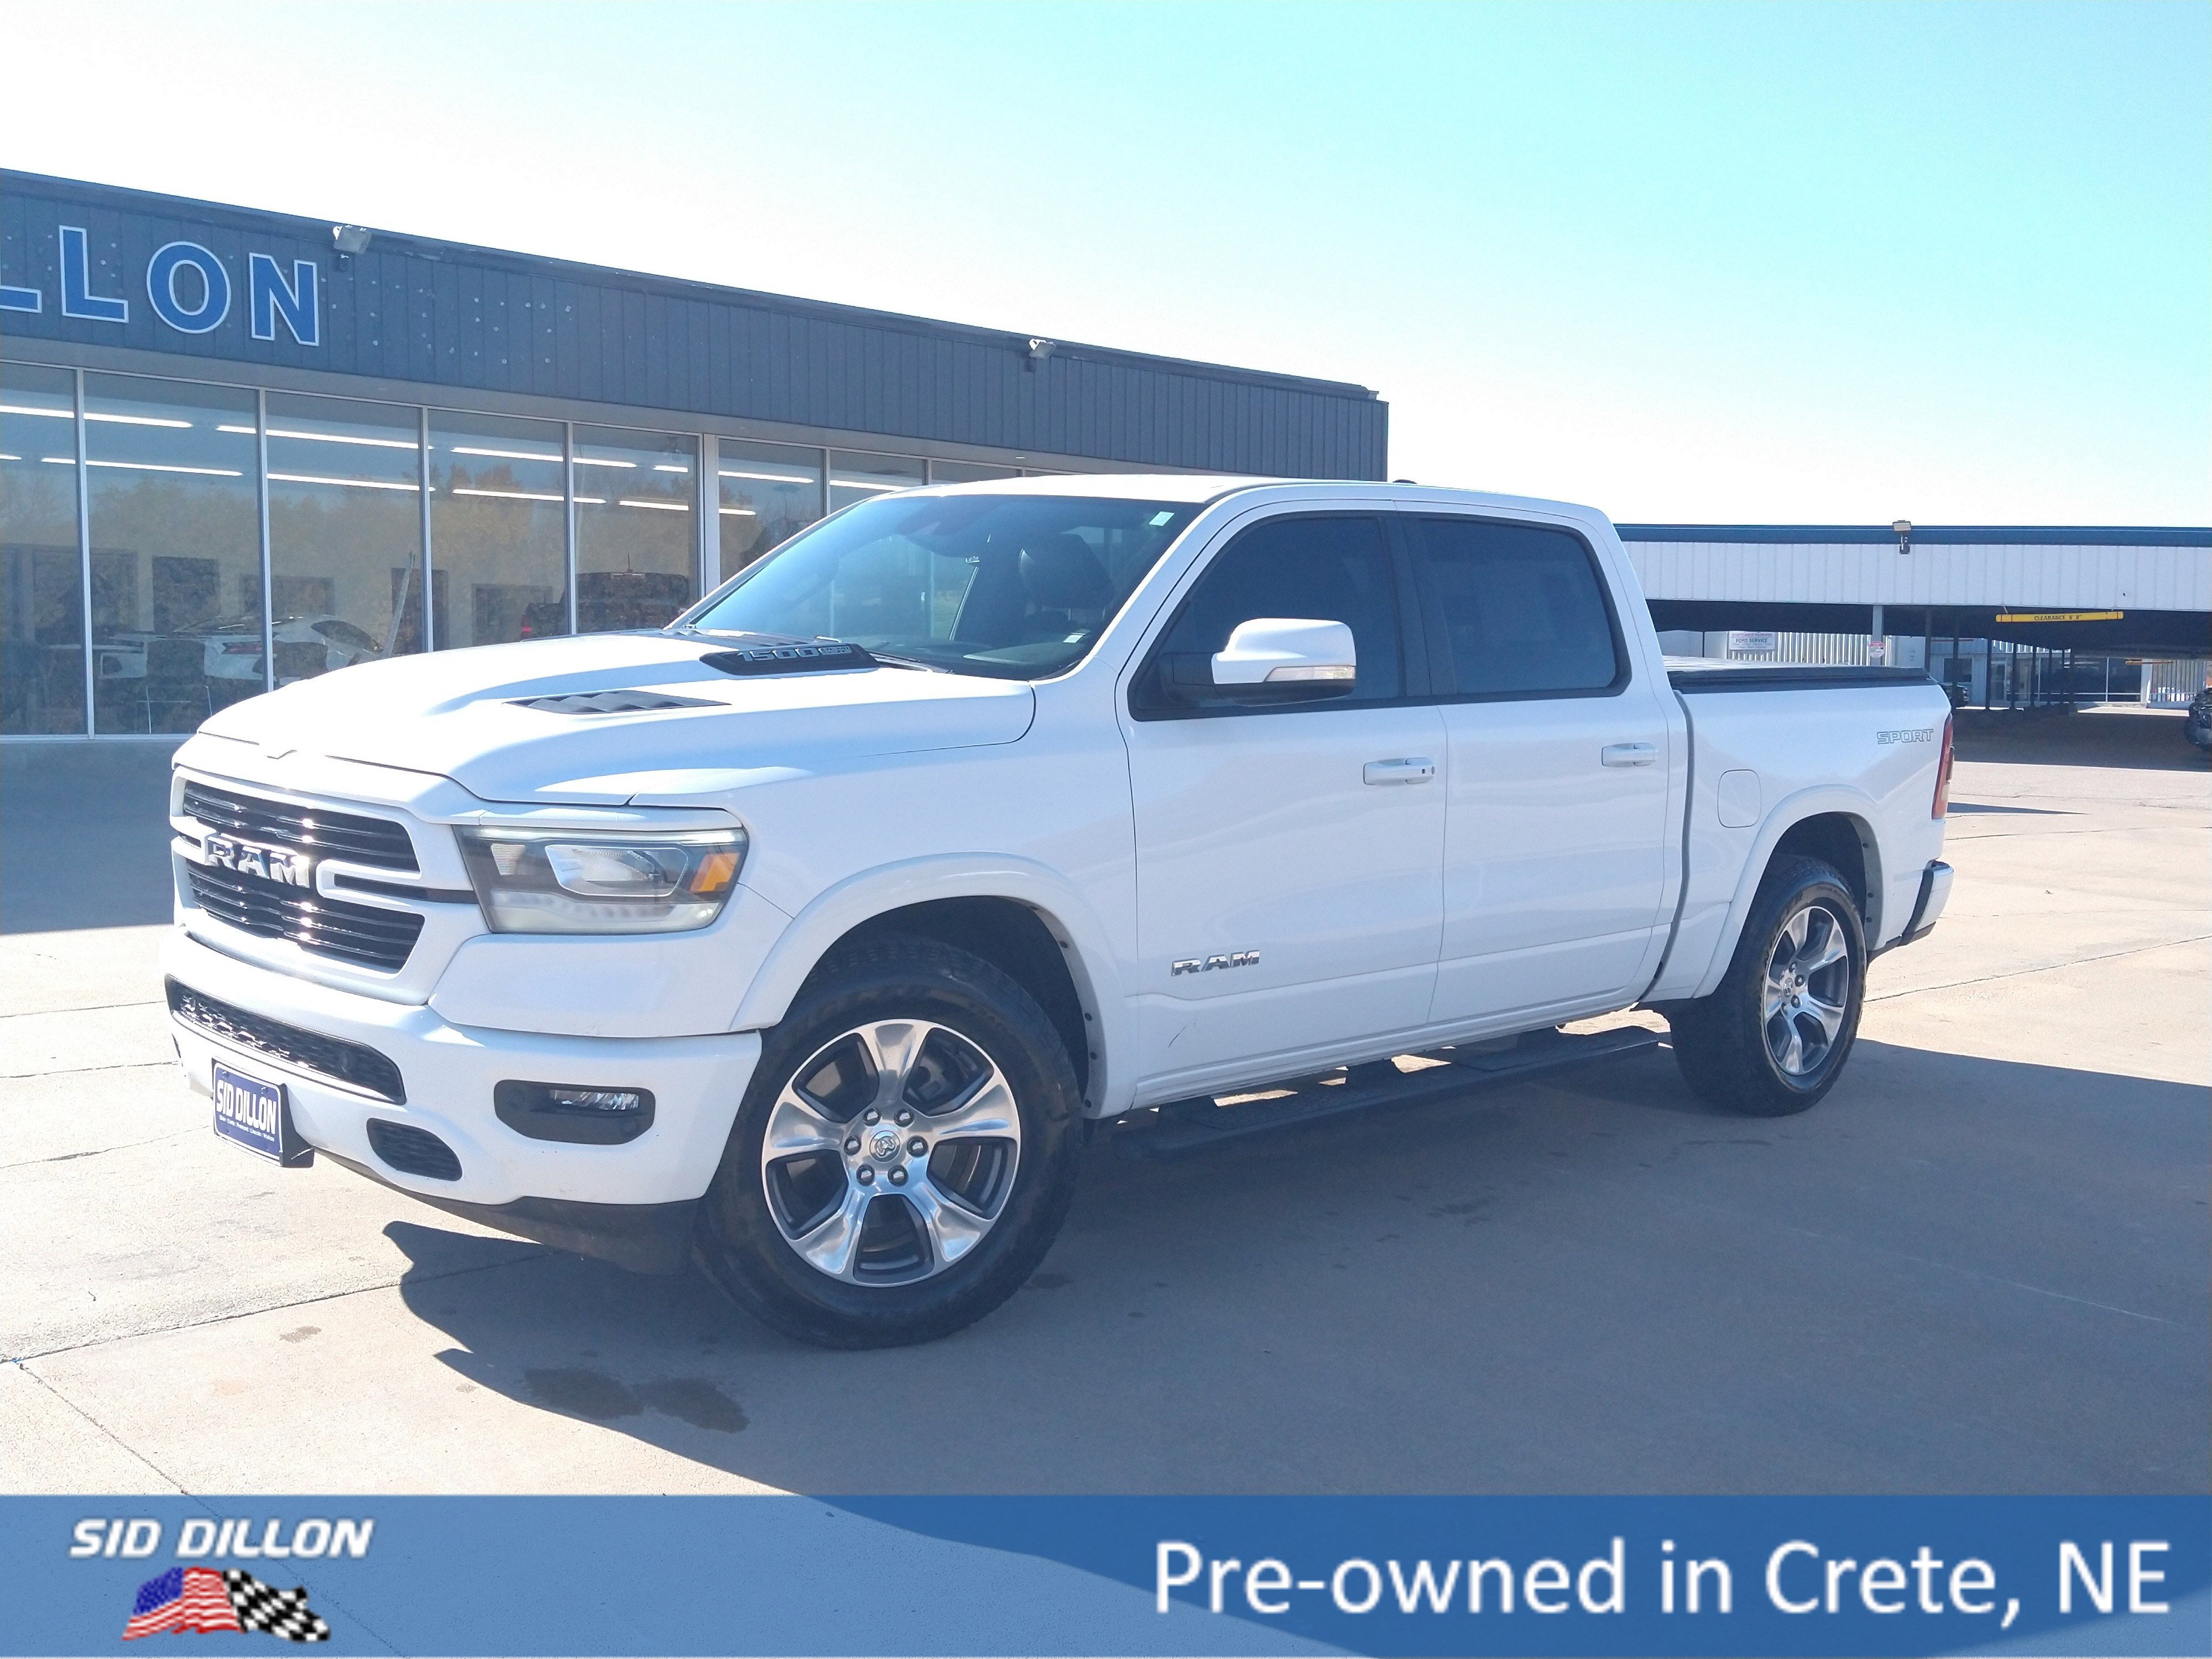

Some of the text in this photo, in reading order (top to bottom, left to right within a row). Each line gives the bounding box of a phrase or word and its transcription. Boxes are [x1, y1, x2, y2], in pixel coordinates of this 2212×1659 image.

[737, 647, 820, 662] 1500
[1876, 728, 1934, 745] SPORT
[206, 835, 310, 889] RAM
[1171, 950, 1260, 977] RAM
[216, 1079, 234, 1118] SID
[235, 1087, 277, 1135] DILLON
